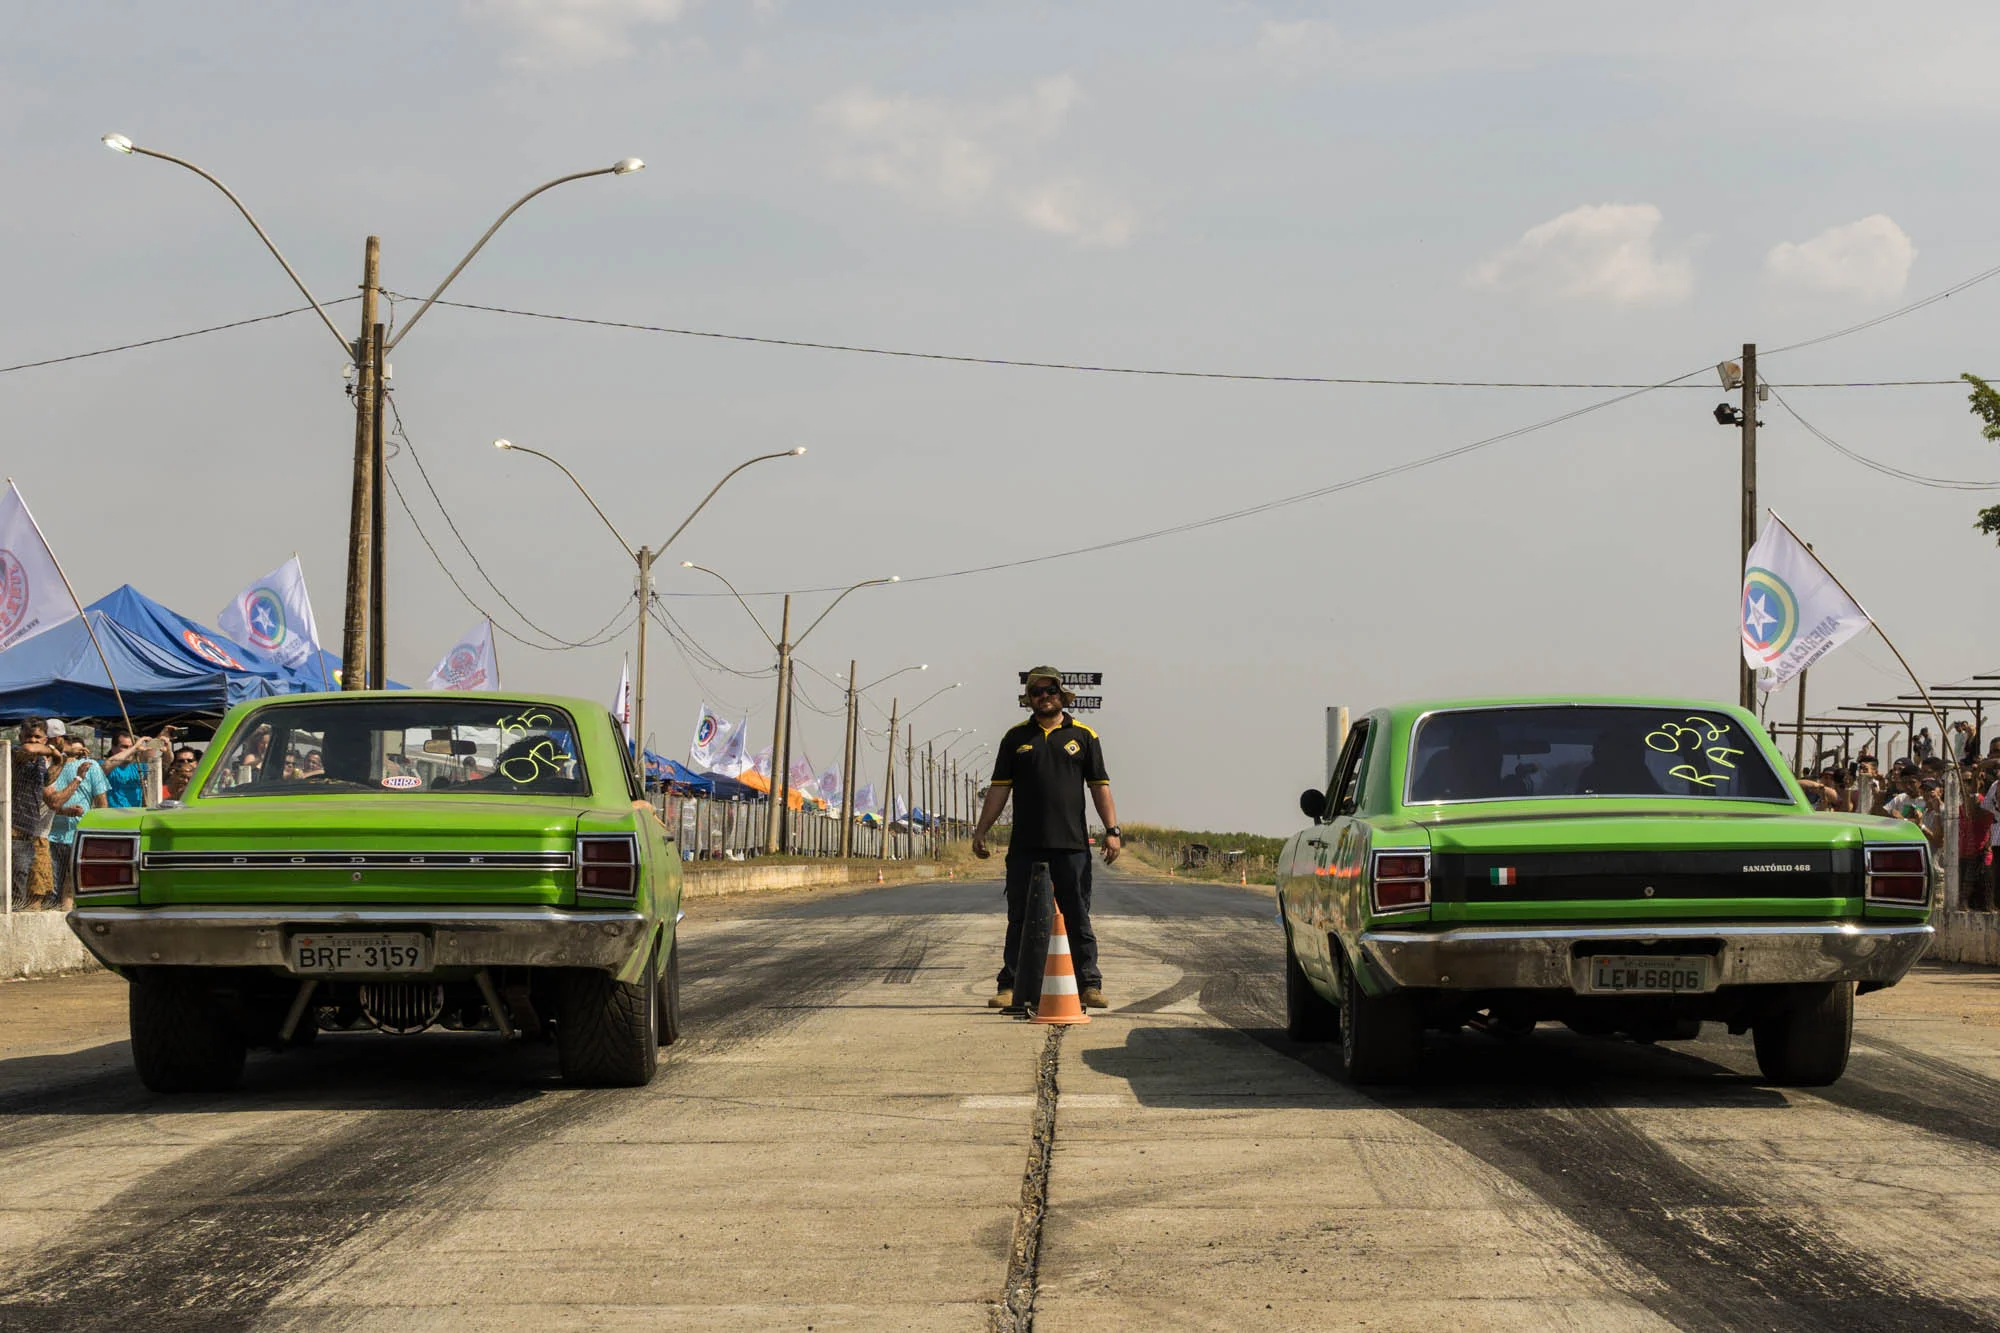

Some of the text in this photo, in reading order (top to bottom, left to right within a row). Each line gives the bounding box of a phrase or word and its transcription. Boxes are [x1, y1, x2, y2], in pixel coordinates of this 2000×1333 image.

[386, 778, 417, 786] NHRA
[1742, 863, 1811, 873] SANATÓRIO 468
